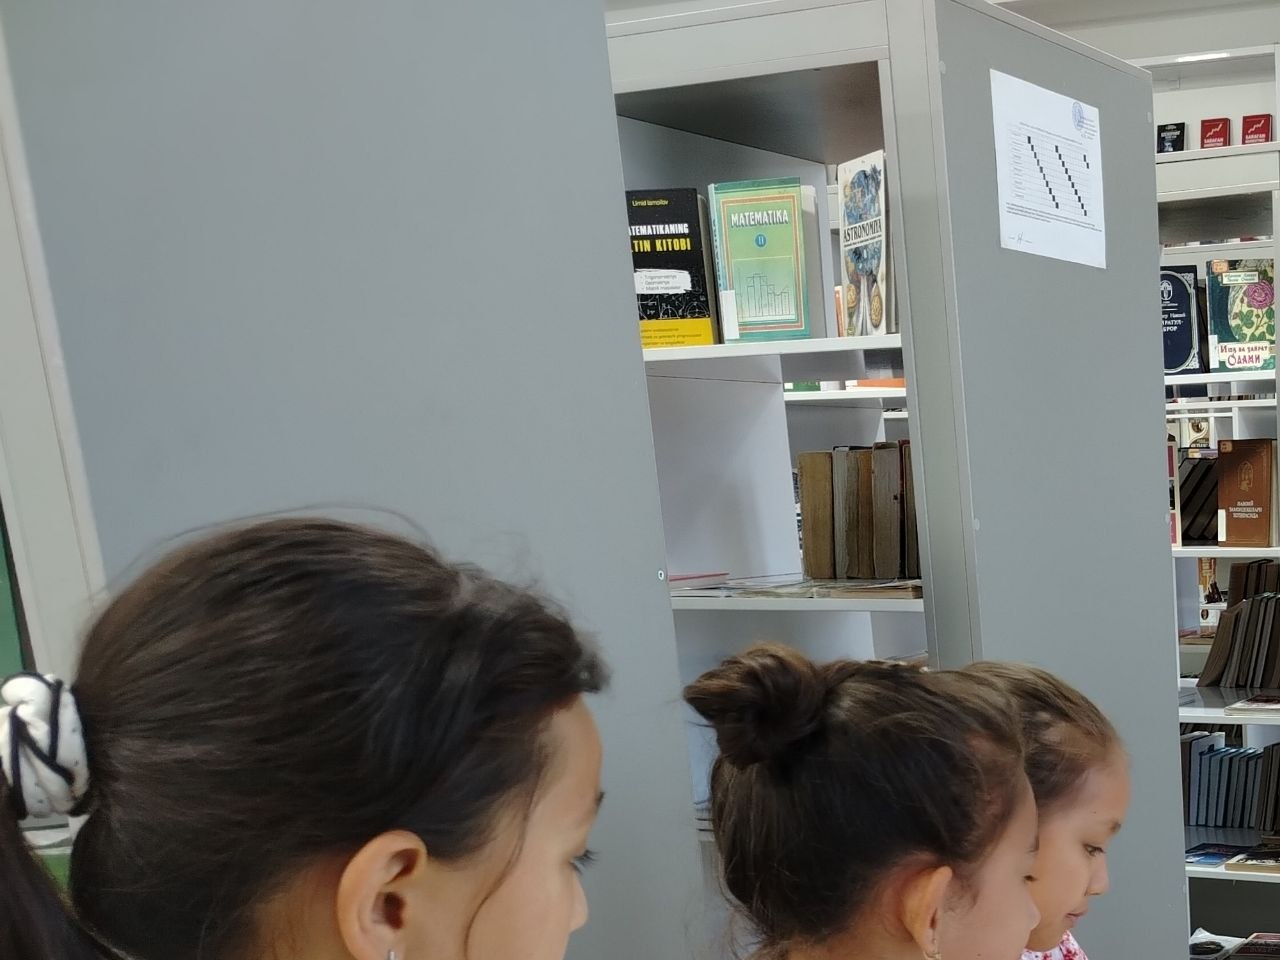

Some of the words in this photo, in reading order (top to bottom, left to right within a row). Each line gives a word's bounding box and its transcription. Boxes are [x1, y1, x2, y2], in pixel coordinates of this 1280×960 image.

[730, 210, 789, 228] MATEMATIKA
[629, 223, 688, 236] TEMATIKANING
[632, 239, 651, 252] TIN
[655, 237, 691, 251] KITOBI
